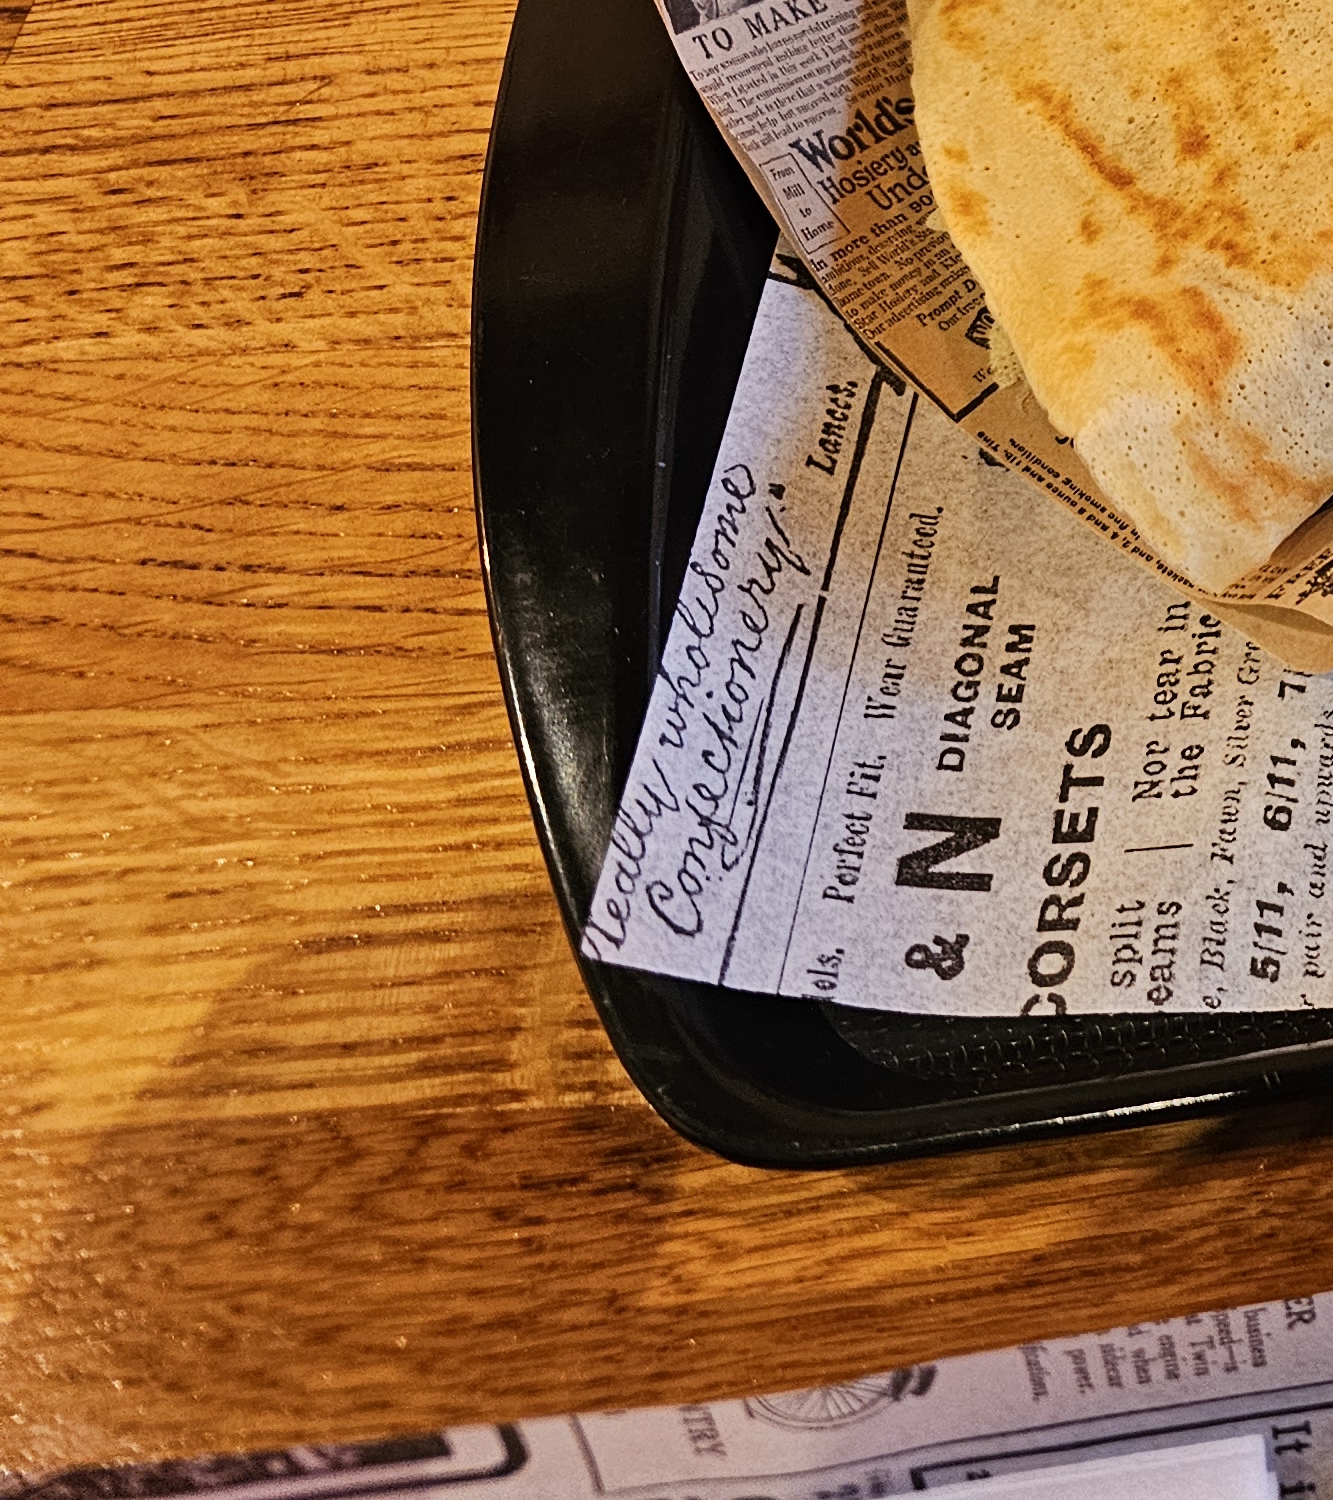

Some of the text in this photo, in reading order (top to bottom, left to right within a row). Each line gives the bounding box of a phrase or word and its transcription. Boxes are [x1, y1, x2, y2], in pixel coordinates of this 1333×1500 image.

[693, 26, 736, 62] TO
[769, 162, 795, 182] From
[788, 95, 915, 167] World's
[782, 182, 805, 202] Mill
[798, 203, 813, 219] to
[821, 145, 909, 207] Hosiery
[799, 215, 837, 243] Home
[917, 290, 963, 326] Prompt
[823, 505, 944, 903] Perfect Fit. Wear Guaranteed.
[936, 574, 1002, 773] DIAGONAL
[991, 623, 1036, 731] SEAM
[1132, 598, 1190, 806] Nor tear in
[1169, 611, 1223, 800] the Fabric
[1198, 685, 1256, 971] Black, Fawn, Silver
[1247, 734, 1307, 984] 5/11, 6/11,
[1299, 841, 1330, 897] and
[894, 808, 1002, 982] & N
[1104, 896, 1150, 990] split
